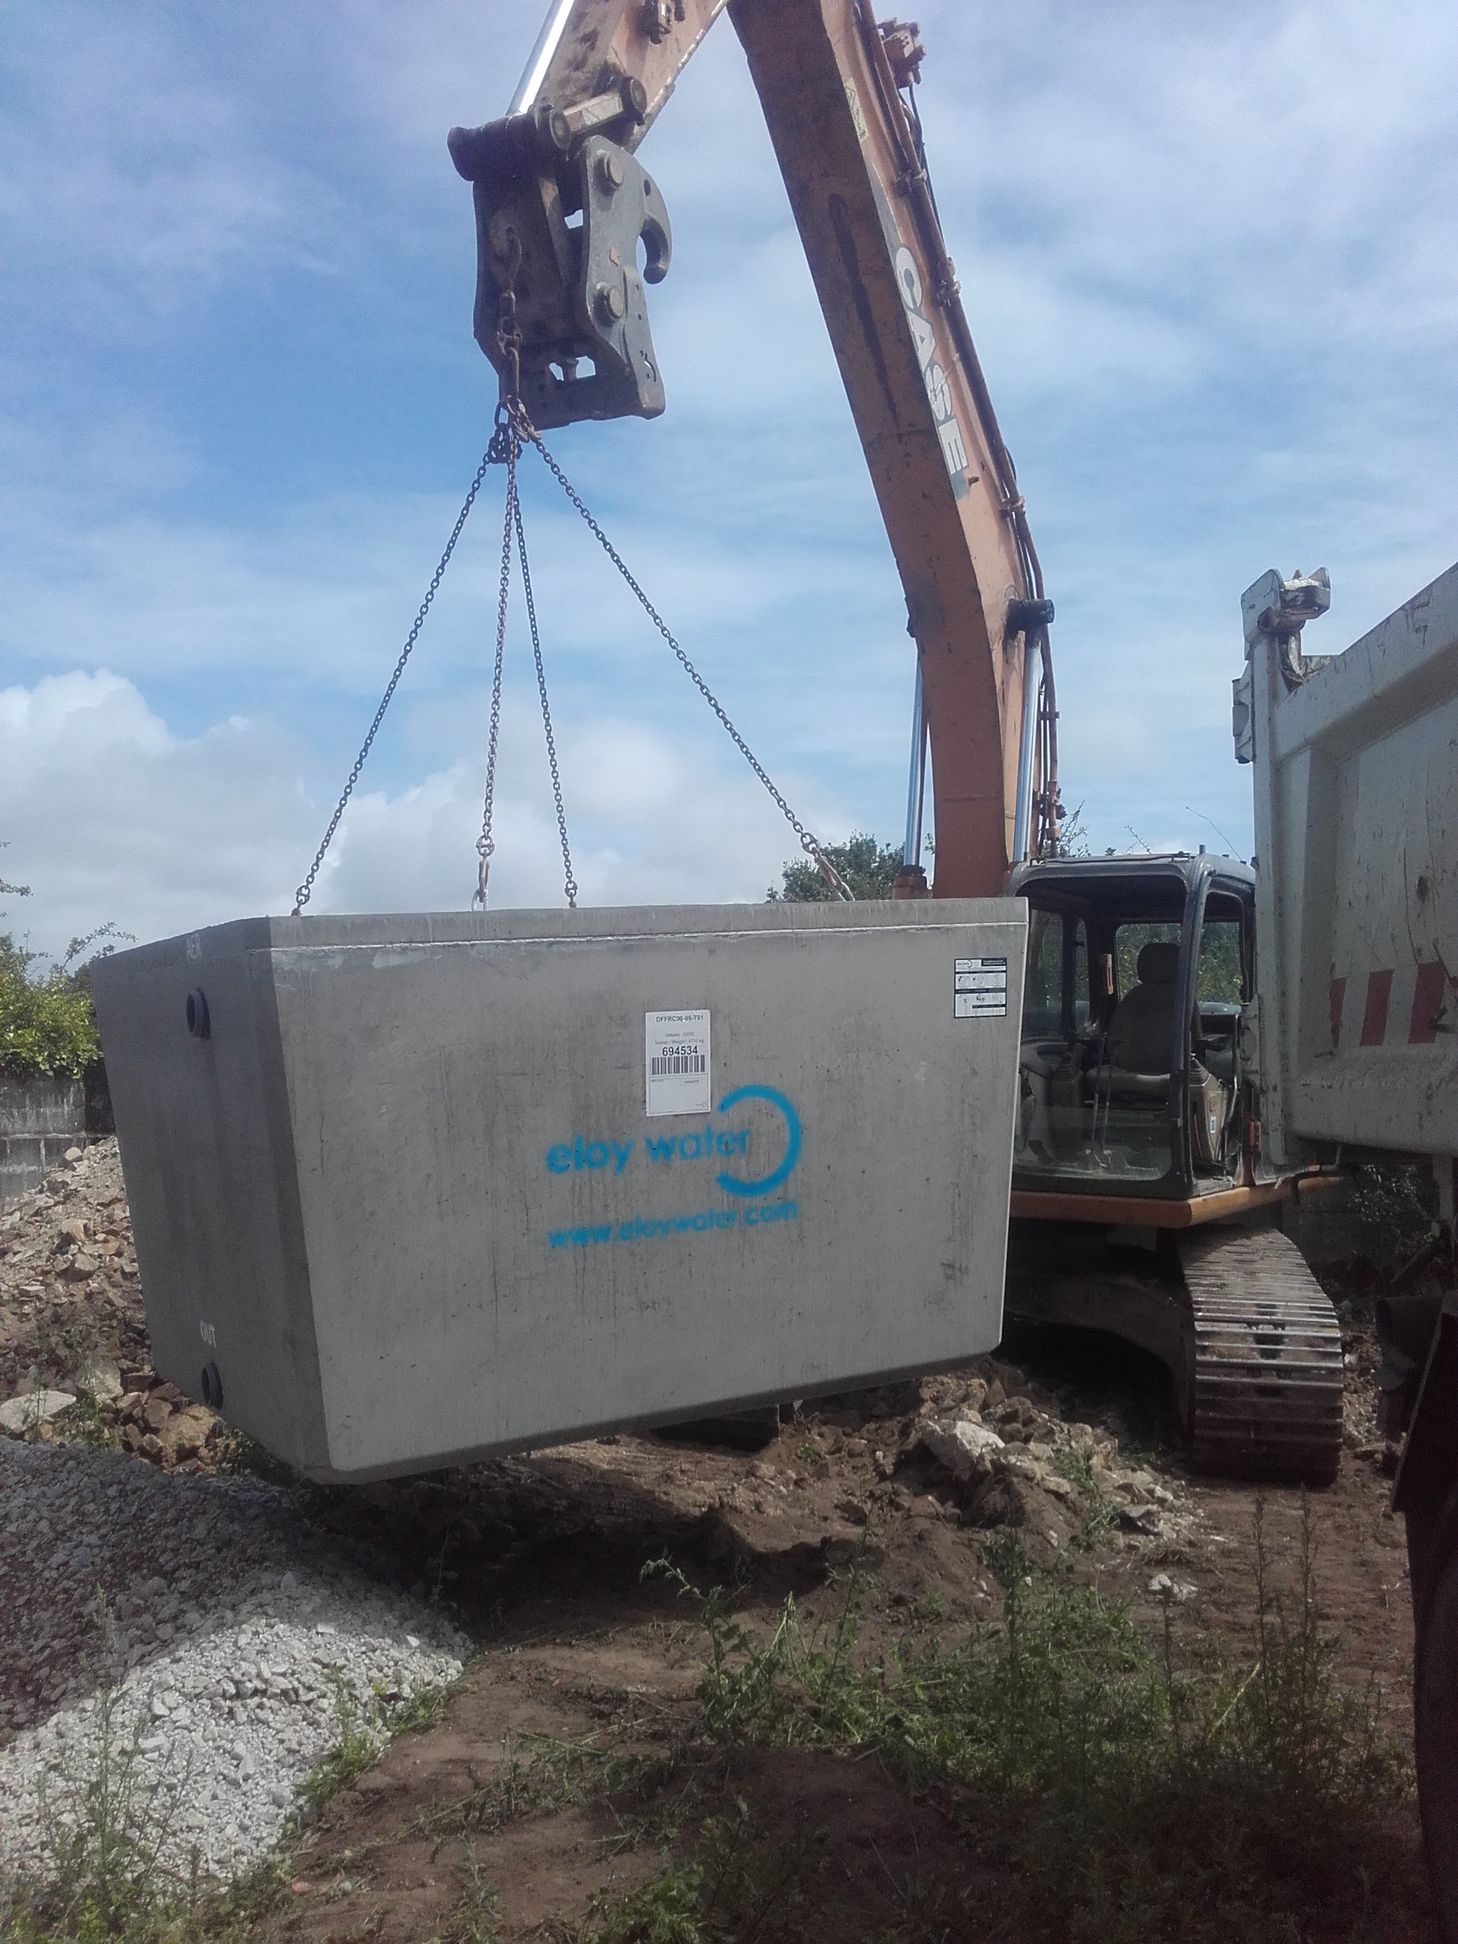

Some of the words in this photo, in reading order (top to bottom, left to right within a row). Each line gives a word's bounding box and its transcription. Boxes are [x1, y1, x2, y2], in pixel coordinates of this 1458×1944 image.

[895, 246, 969, 476] CASE
[662, 1045, 698, 1057] 694534
[546, 1133, 635, 1177] eloy
[645, 1123, 751, 1163] water
[548, 1201, 799, 1249] www.eloywater.com
